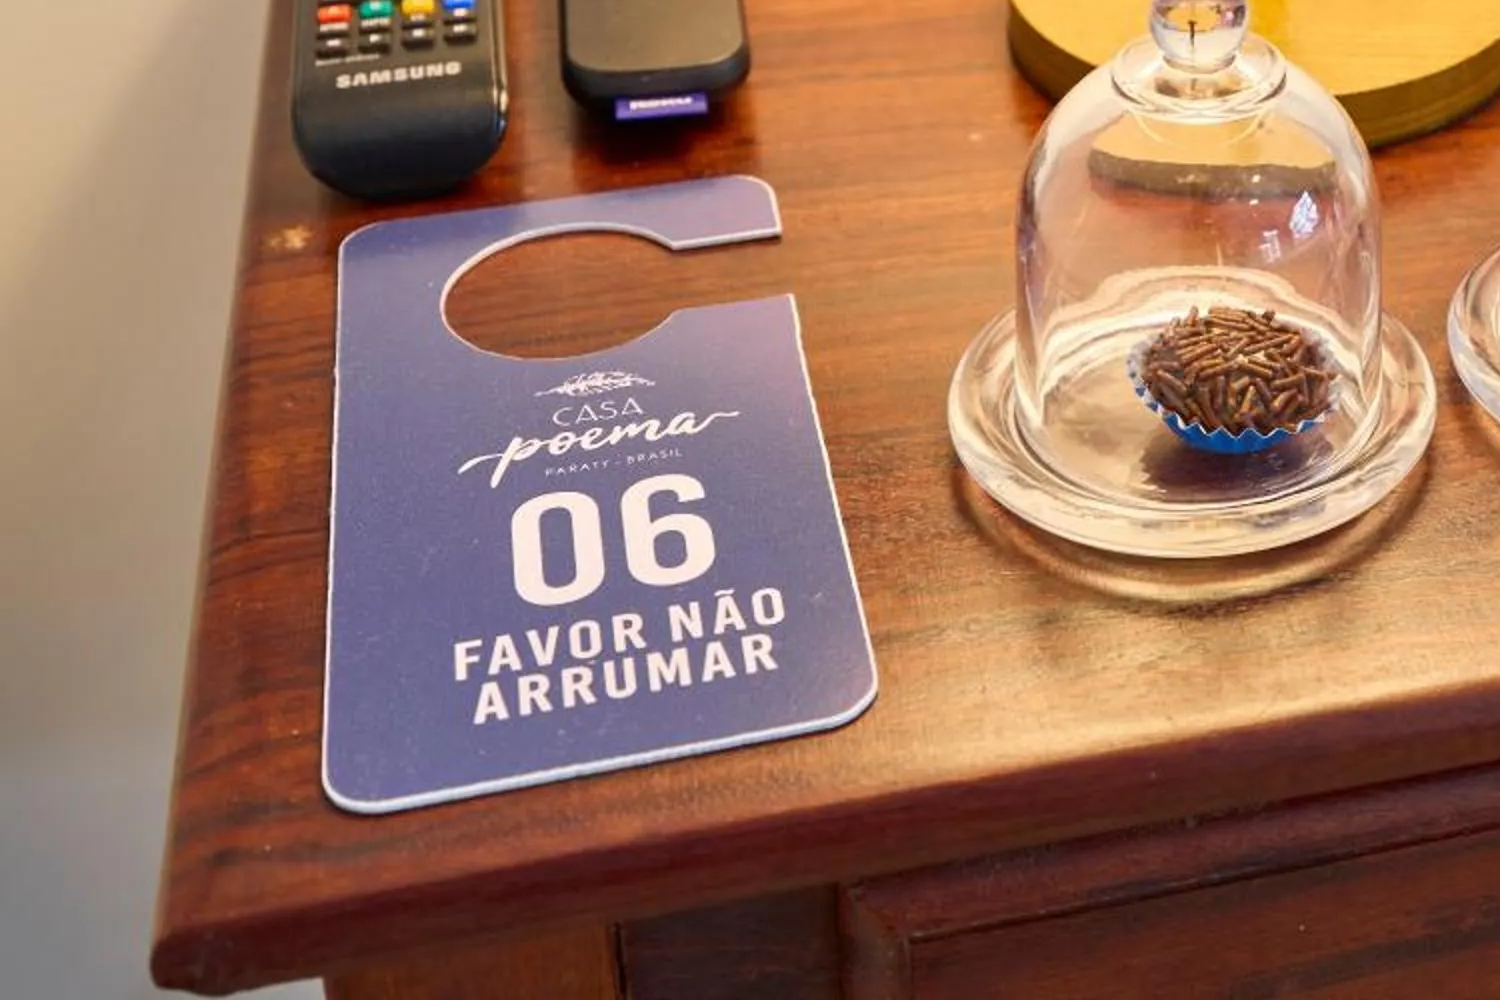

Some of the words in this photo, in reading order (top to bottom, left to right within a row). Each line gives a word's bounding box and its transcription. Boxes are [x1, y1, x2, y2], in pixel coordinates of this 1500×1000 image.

[335, 60, 463, 90] SAMSUNG
[457, 411, 741, 489] poema
[553, 397, 645, 427] CASA
[545, 459, 611, 477] PARATY
[626, 449, 684, 465] BRASIL
[511, 473, 716, 606] 06
[453, 612, 647, 682] FAVOR
[668, 587, 787, 644] NÃO
[472, 633, 780, 725] ARRUMAR
